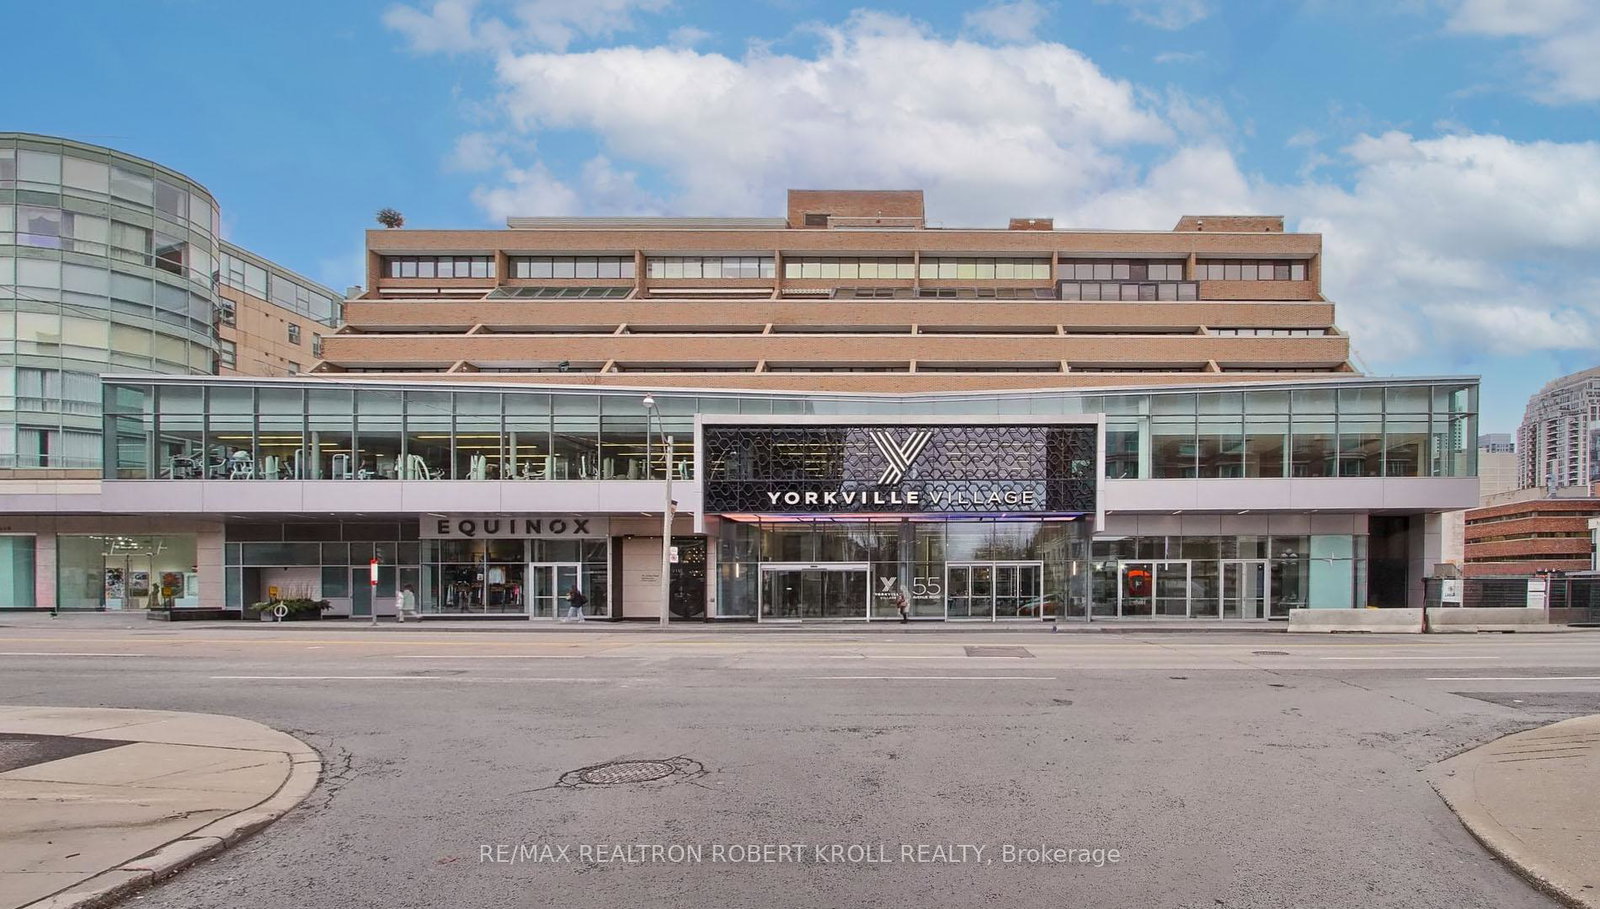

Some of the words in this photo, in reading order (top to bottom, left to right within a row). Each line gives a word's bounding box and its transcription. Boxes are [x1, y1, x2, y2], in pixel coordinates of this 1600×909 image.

[767, 491, 919, 505] YORKVILLE
[929, 491, 1034, 505] VILLAGE
[437, 519, 590, 537] EQUINOX
[912, 576, 941, 595] 55
